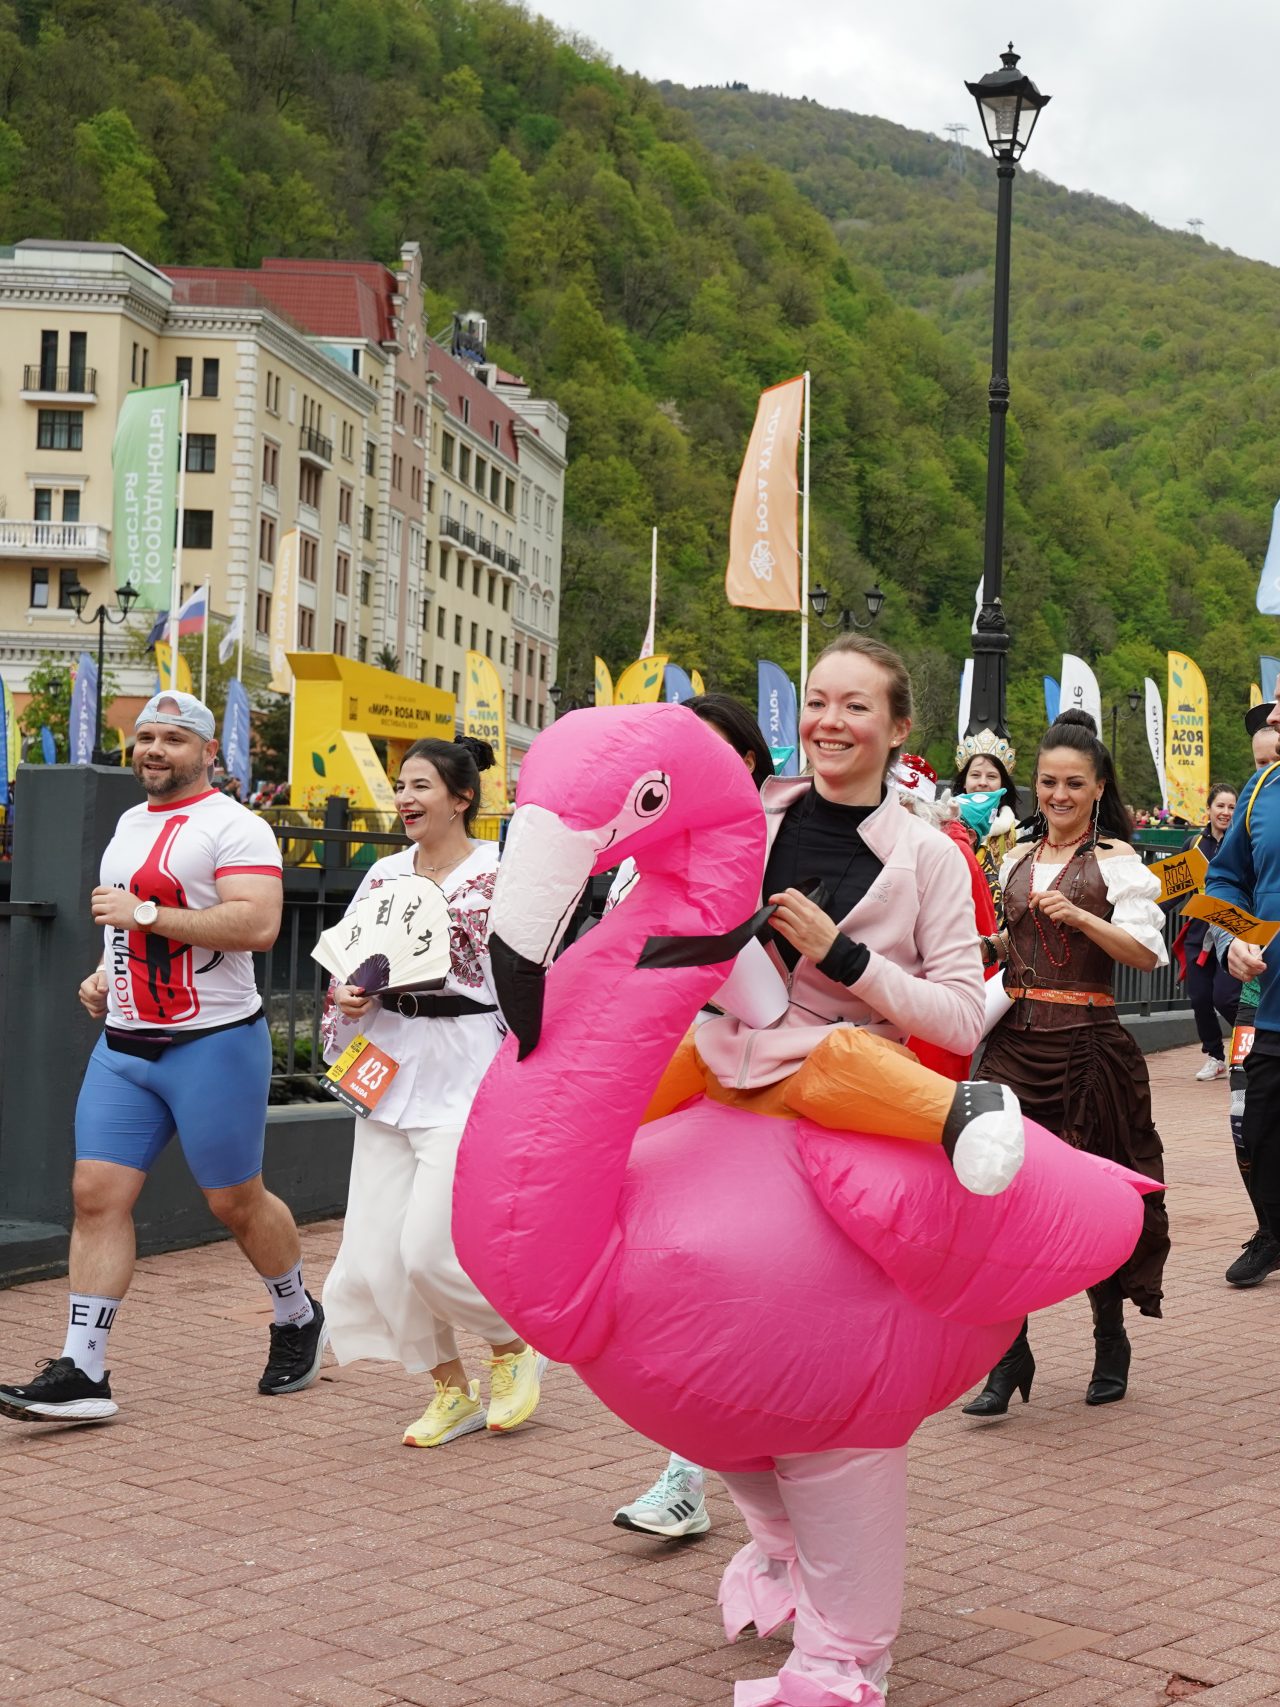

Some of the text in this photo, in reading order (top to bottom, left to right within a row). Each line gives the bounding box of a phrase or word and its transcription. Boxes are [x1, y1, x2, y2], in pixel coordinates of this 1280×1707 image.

[395, 706, 414, 719] ROSA
[415, 708, 431, 721] RUN
[1164, 864, 1192, 888] ROSA
[1167, 880, 1194, 895] RUN
[357, 1057, 389, 1090] 423
